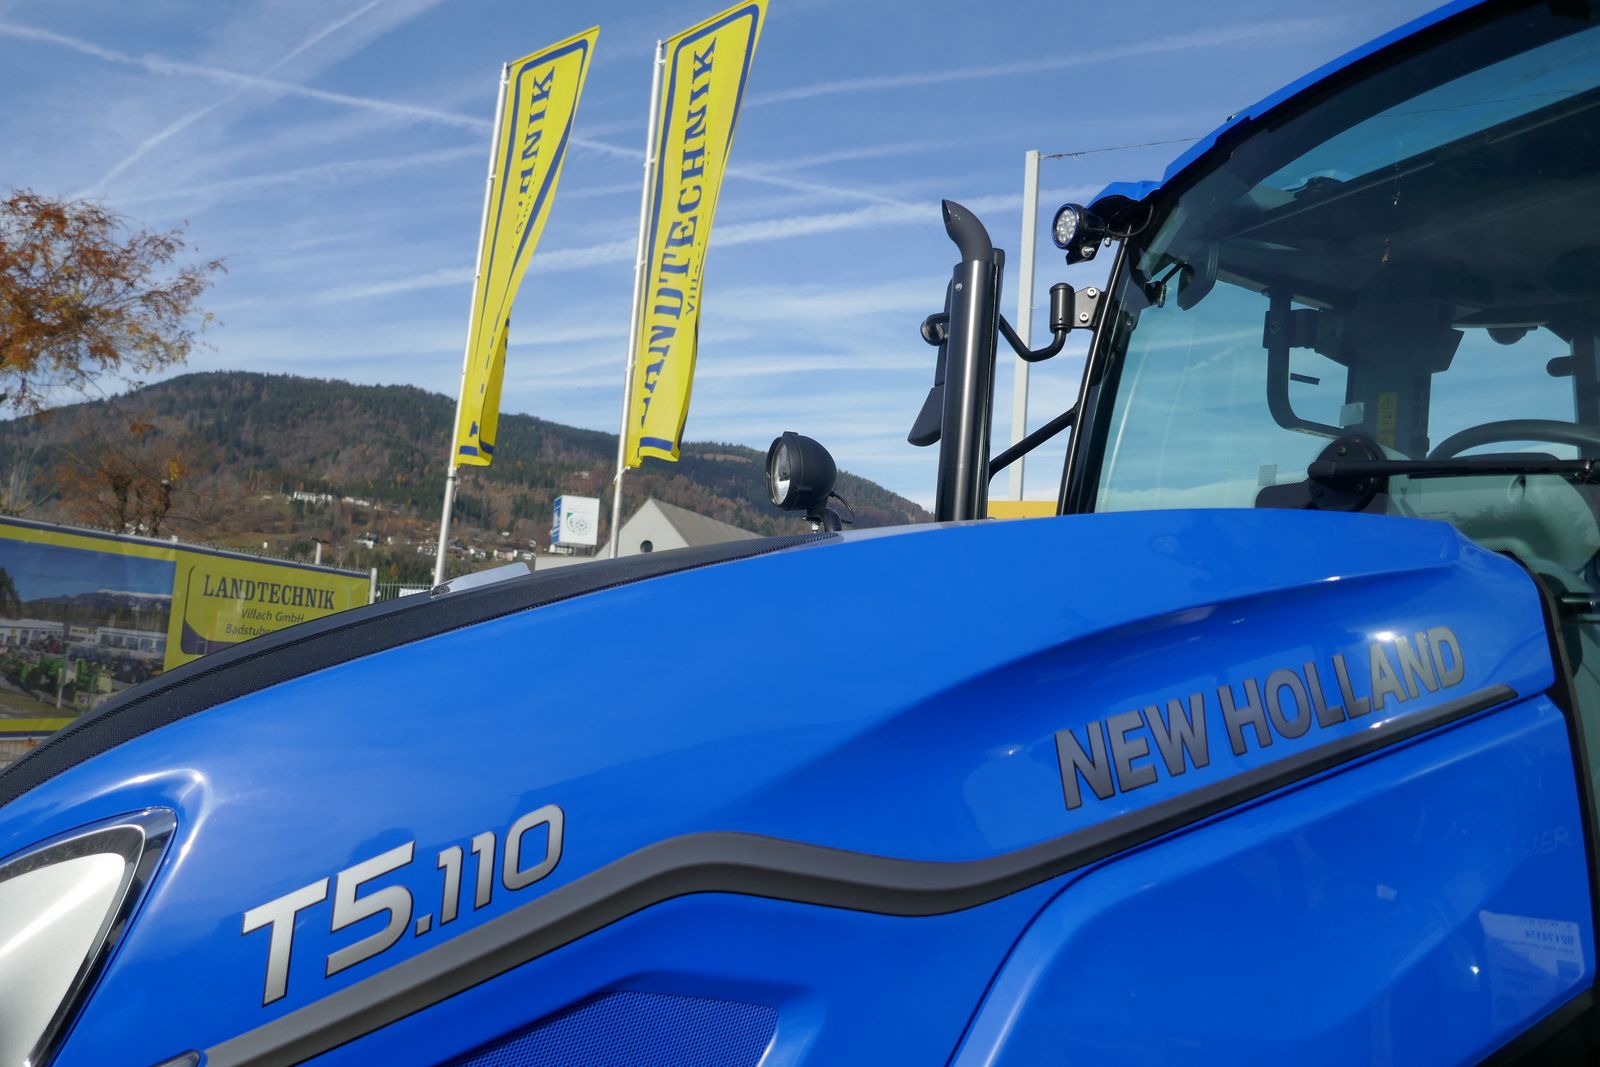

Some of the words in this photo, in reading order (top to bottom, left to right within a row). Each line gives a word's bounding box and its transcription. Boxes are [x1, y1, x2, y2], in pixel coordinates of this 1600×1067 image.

[203, 574, 336, 610] LANDTECHNIK
[241, 607, 273, 621] Villach
[275, 611, 305, 623] GmbH
[1054, 692, 1210, 811] NEW
[1217, 626, 1466, 757] HOLLAND
[241, 803, 565, 1009] T5.110
